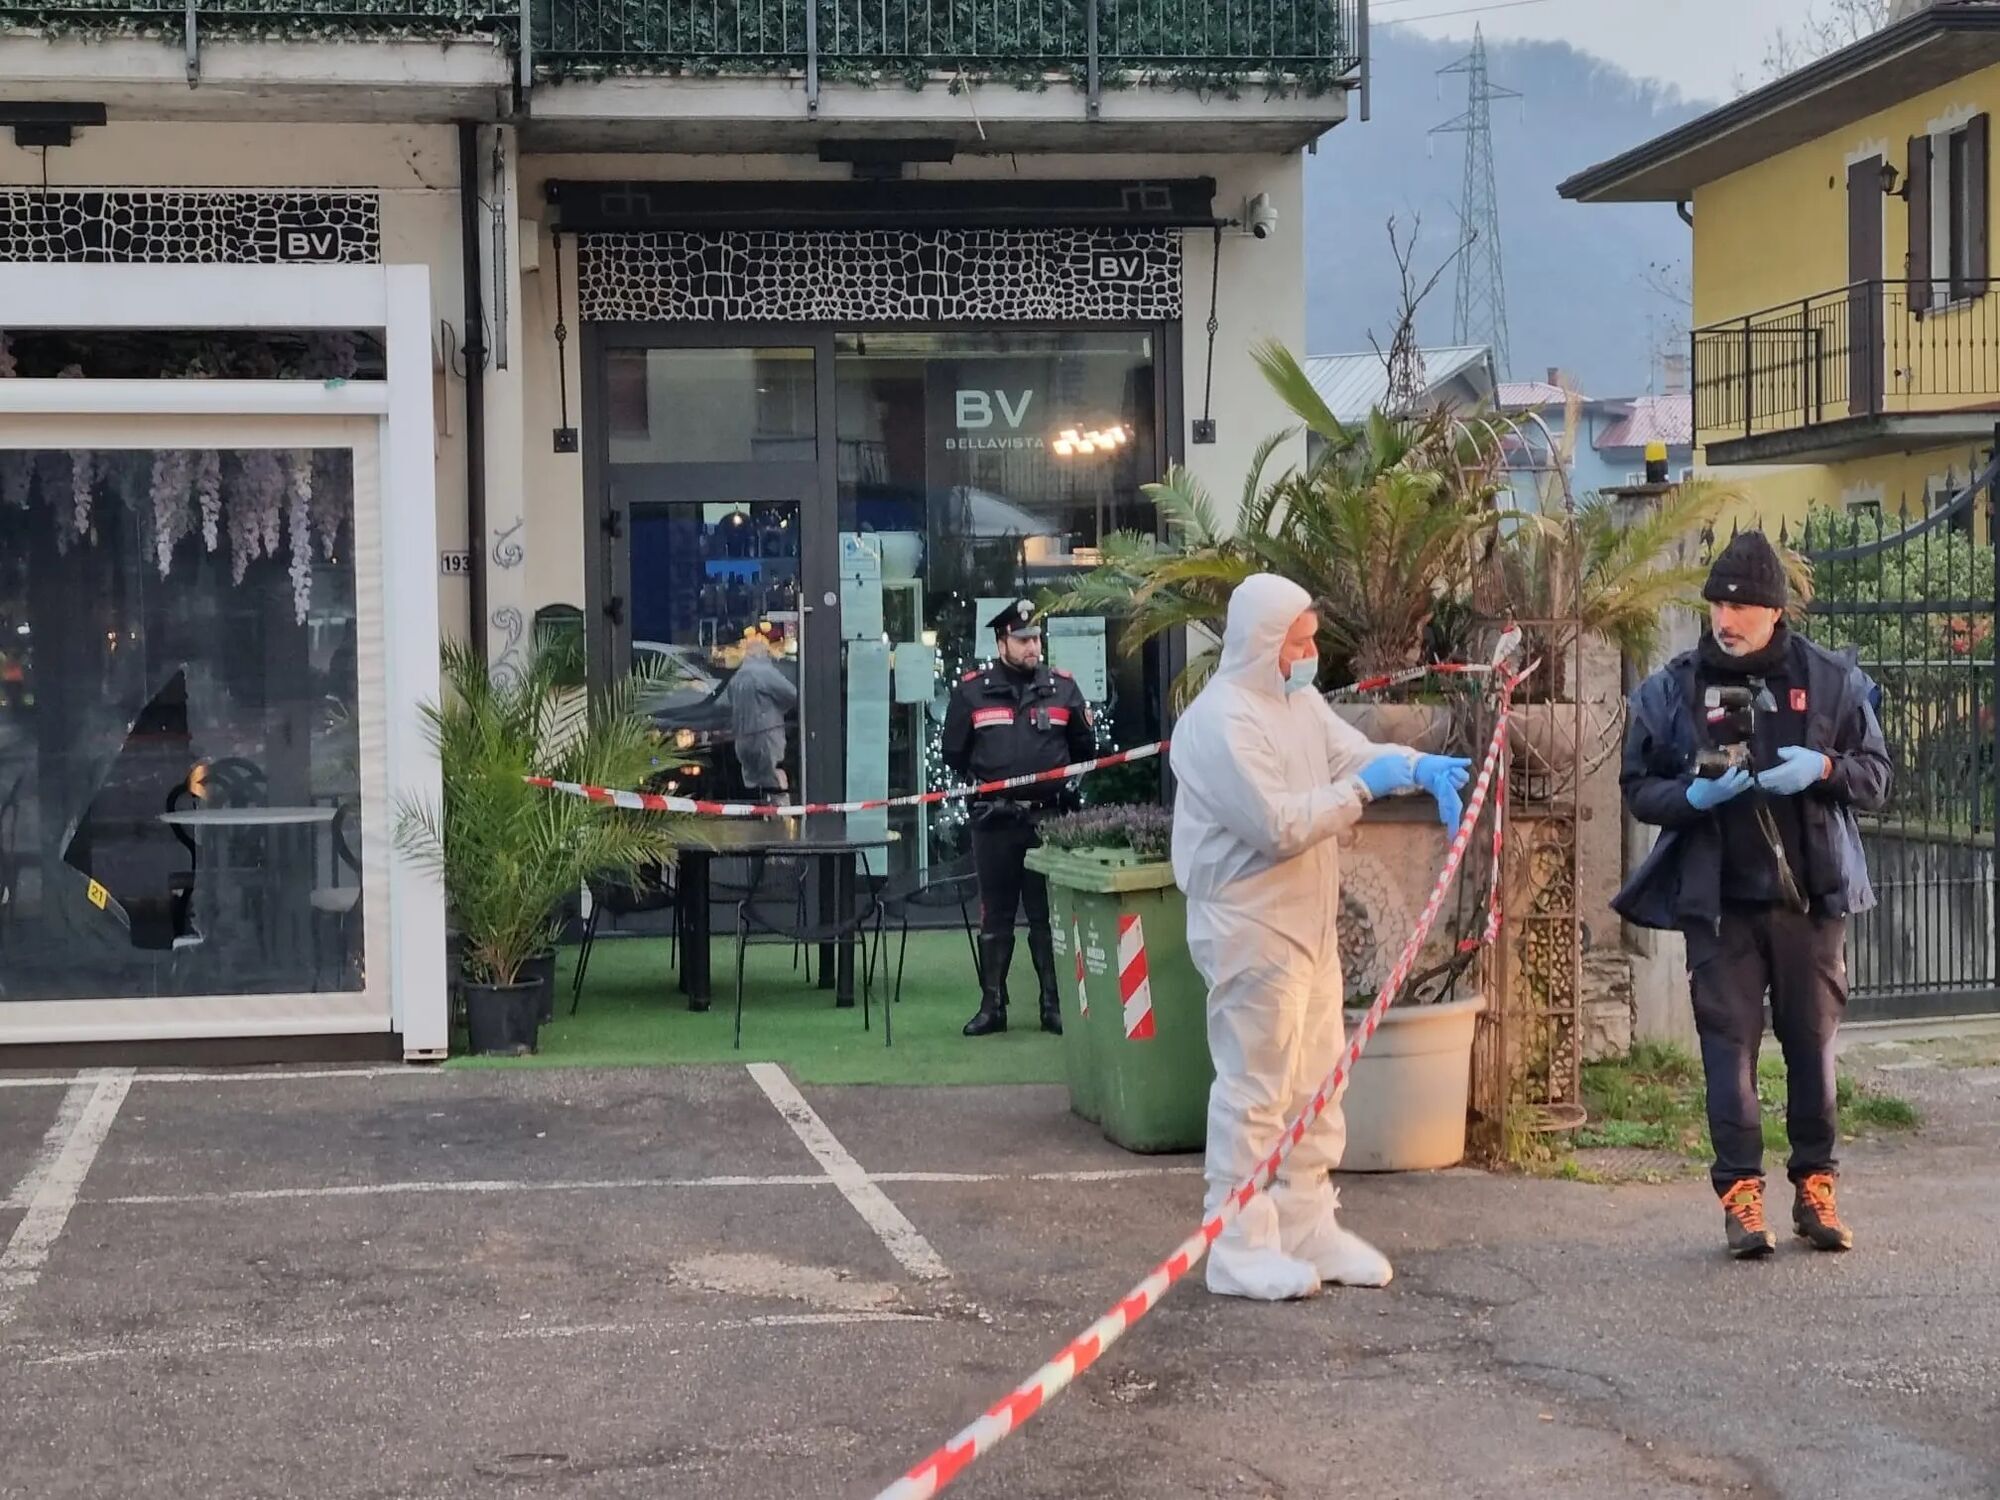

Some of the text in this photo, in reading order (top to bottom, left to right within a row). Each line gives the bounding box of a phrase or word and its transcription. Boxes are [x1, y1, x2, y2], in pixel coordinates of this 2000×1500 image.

[288, 233, 332, 255] BV
[1100, 256, 1140, 277] BV
[956, 389, 1033, 428] BV
[945, 438, 1044, 450] BELLAVISTA
[444, 555, 470, 571] 193
[91, 884, 103, 902] 21
